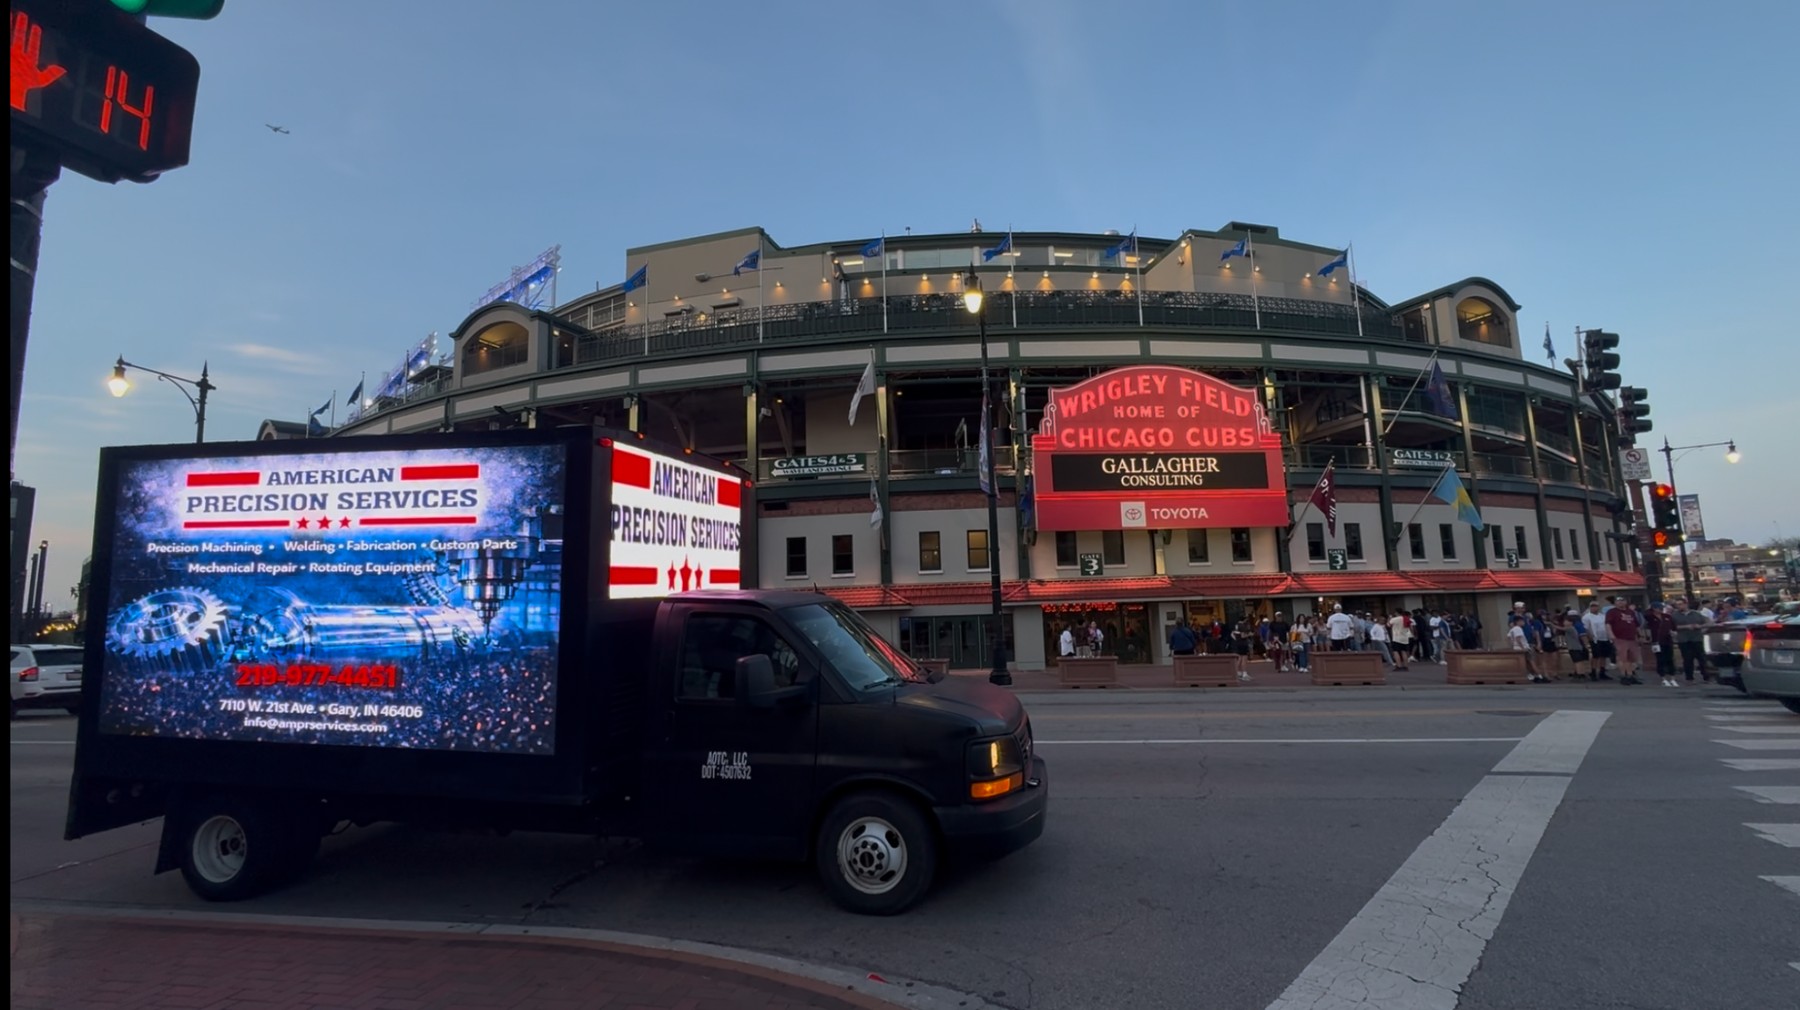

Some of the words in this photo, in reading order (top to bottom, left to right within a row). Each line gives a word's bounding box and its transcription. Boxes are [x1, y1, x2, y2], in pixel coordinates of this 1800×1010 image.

[101, 65, 154, 151] 14
[1059, 375, 1167, 418] WRIGLEY
[1180, 377, 1251, 417] FIELD
[1113, 405, 1165, 418] HOME
[1177, 405, 1200, 418] OF
[1061, 427, 1174, 448] CHICAGO
[1186, 427, 1254, 447] CUBS
[774, 456, 828, 469] GATES
[1394, 449, 1432, 460] GATES
[1101, 457, 1220, 474] GALLAGHER
[267, 468, 395, 486] AMERICAN
[653, 461, 715, 506] AMERICAN
[1120, 474, 1203, 487] CONSULTING
[186, 493, 328, 513] PRECISION
[337, 489, 478, 510] SERVICES
[1151, 508, 1209, 520] TOYOTA
[611, 504, 687, 547] PRECISION
[691, 515, 741, 551] SERVICES
[148, 543, 199, 553] Precision
[202, 542, 263, 555] Machining
[284, 541, 336, 554] Welding
[346, 540, 416, 551] Fabrication
[430, 540, 479, 550] Custom
[483, 539, 517, 550] Parts
[188, 562, 254, 573] Mechanical
[257, 563, 298, 575] Repair
[309, 562, 362, 575] Rotating
[366, 562, 436, 575] Equipment
[1085, 559, 1099, 571] 3
[1332, 554, 1344, 566] 3
[236, 664, 397, 688] 219-977-4451
[219, 699, 245, 711] 7110
[248, 701, 264, 713] W.
[266, 701, 290, 713] 21st
[291, 702, 317, 714] Ave.
[327, 704, 361, 718] Gary,
[364, 704, 379, 716] IN
[380, 705, 423, 718] 46406
[244, 716, 388, 733] info@amprservices.com
[733, 752, 748, 766] LLC
